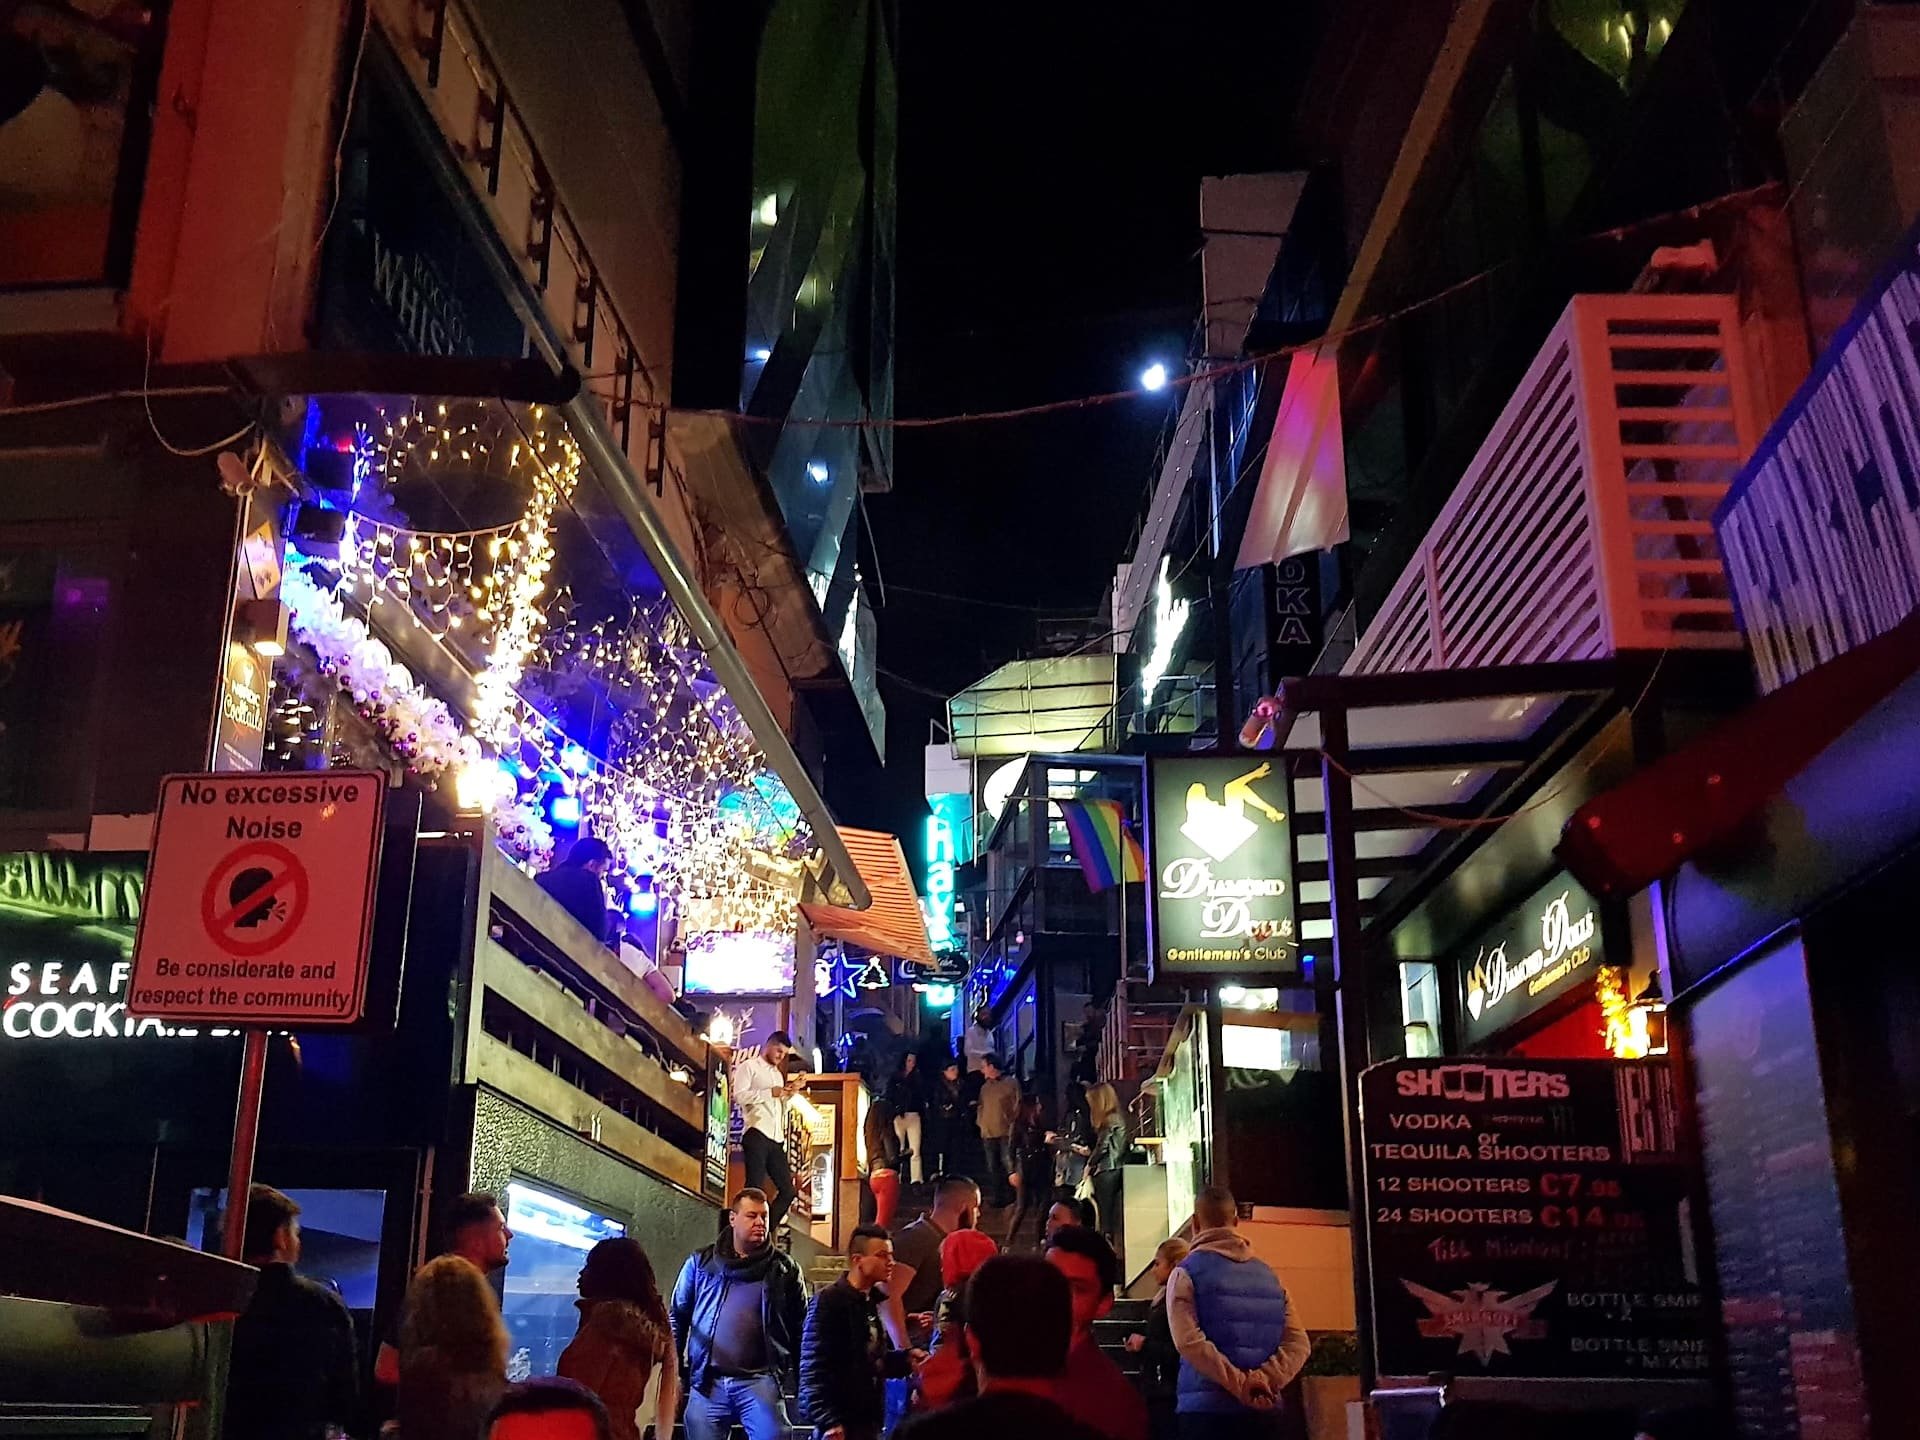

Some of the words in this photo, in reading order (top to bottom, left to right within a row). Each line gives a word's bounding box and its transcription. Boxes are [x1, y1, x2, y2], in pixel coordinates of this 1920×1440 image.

[181, 783, 216, 804] No
[226, 781, 359, 803] excessive
[227, 816, 303, 840] Noise
[1167, 947, 1251, 961] Gentlemen's
[1254, 947, 1287, 960] Club
[156, 959, 181, 977] Be
[185, 960, 293, 979] considerate
[300, 961, 336, 979] and
[7, 962, 132, 996] SEAF
[134, 988, 204, 1008] respect
[209, 987, 241, 1005] the
[244, 988, 351, 1012] community
[1388, 1113, 1473, 1130] VODKA
[1478, 1131, 1501, 1146] or
[1370, 1143, 1472, 1161] TEQUILA
[1479, 1144, 1612, 1162] SHOOTERS
[1377, 1177, 1401, 1193] 12
[1407, 1177, 1532, 1194] SHOOTERS
[1377, 1207, 1402, 1223] 24
[1408, 1208, 1535, 1225] SHOOTERS
